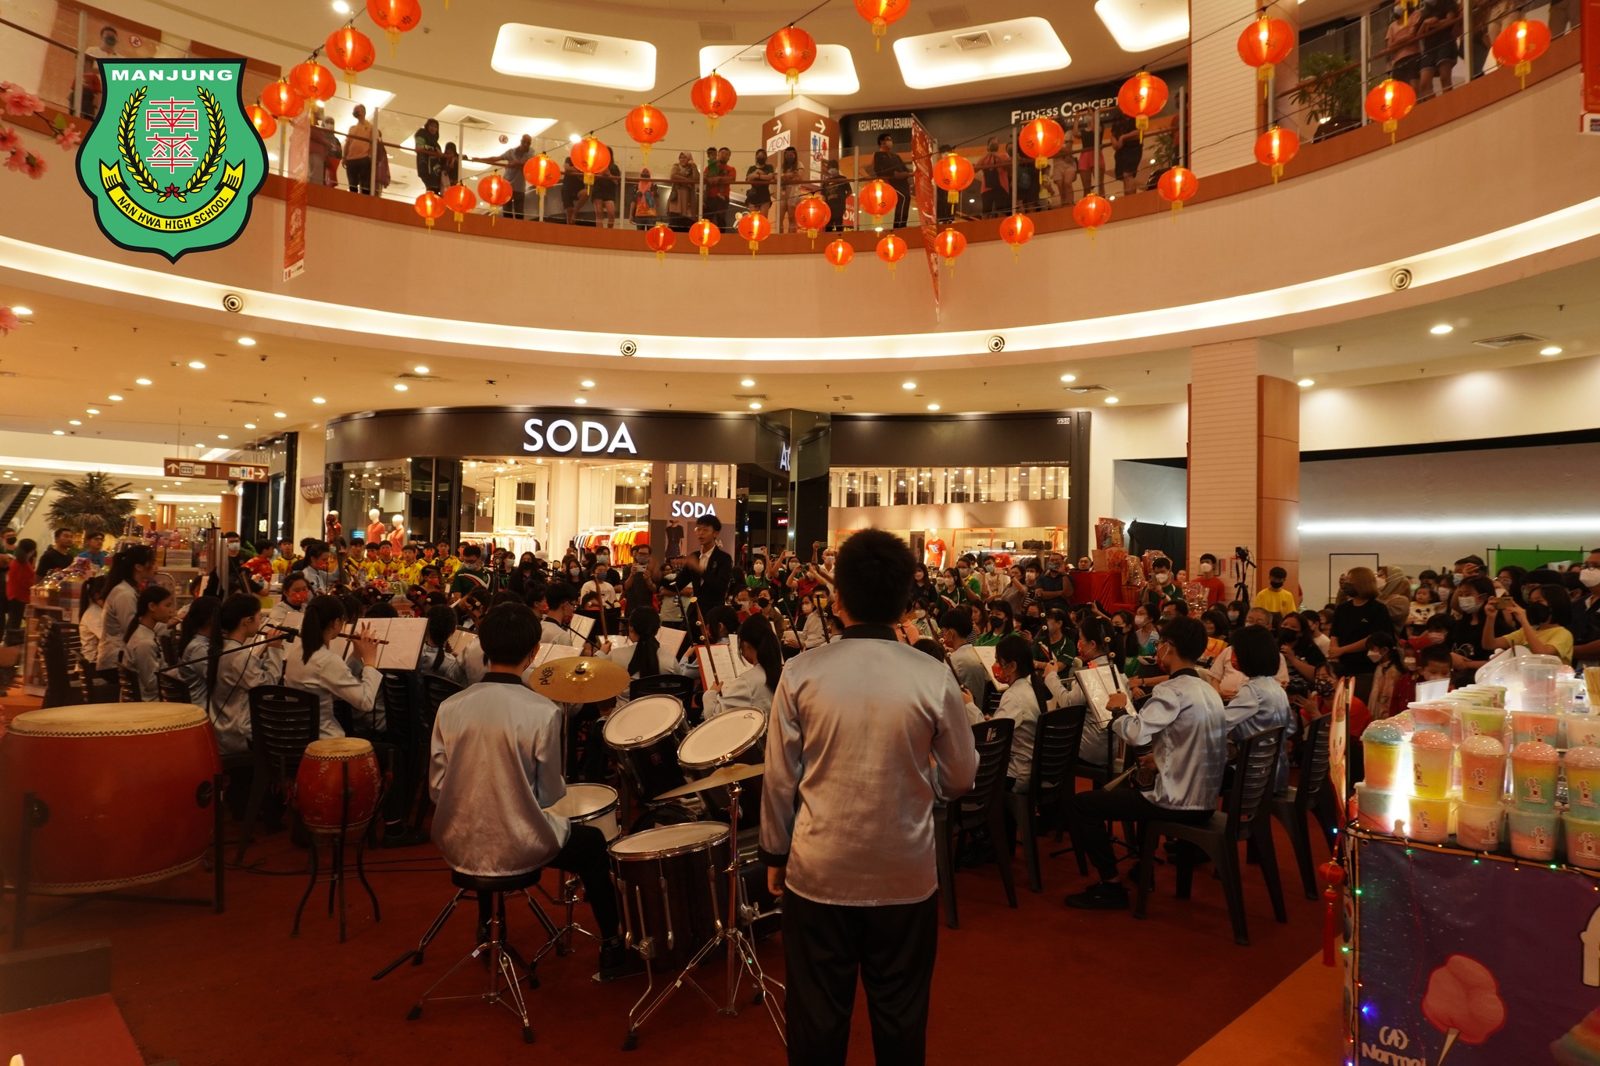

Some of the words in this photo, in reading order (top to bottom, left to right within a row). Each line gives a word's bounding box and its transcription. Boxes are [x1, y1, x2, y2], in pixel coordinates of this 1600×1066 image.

[1011, 107, 1058, 124] FITNESS
[522, 418, 637, 454] SODA
[671, 500, 716, 519] SODA
